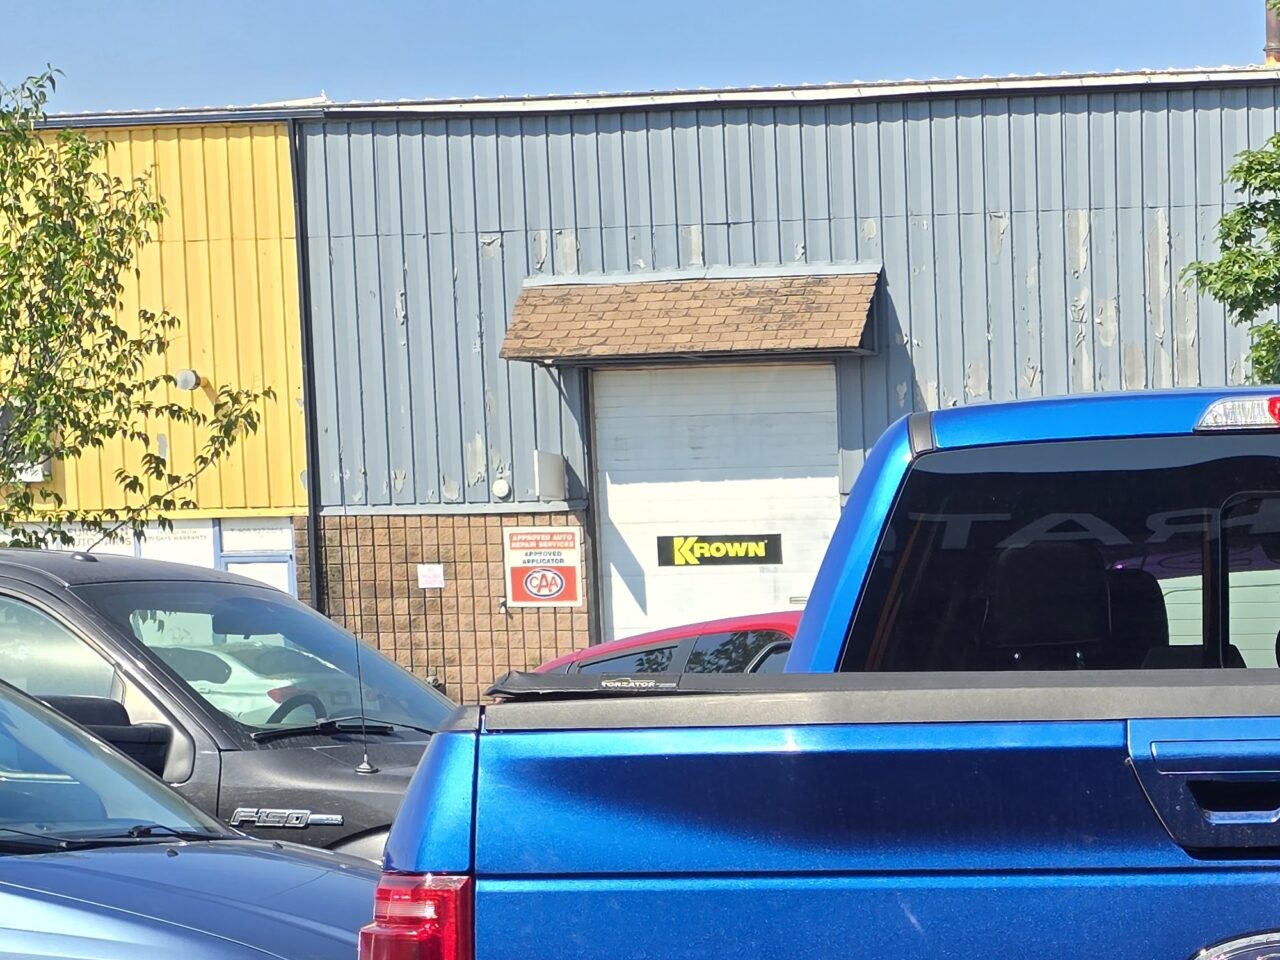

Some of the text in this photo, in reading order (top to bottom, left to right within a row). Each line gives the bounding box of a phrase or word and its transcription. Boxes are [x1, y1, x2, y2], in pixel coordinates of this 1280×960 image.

[511, 533, 573, 541] APPROVED AUTO
[673, 536, 766, 565] KROWN
[529, 573, 559, 593] CAA
